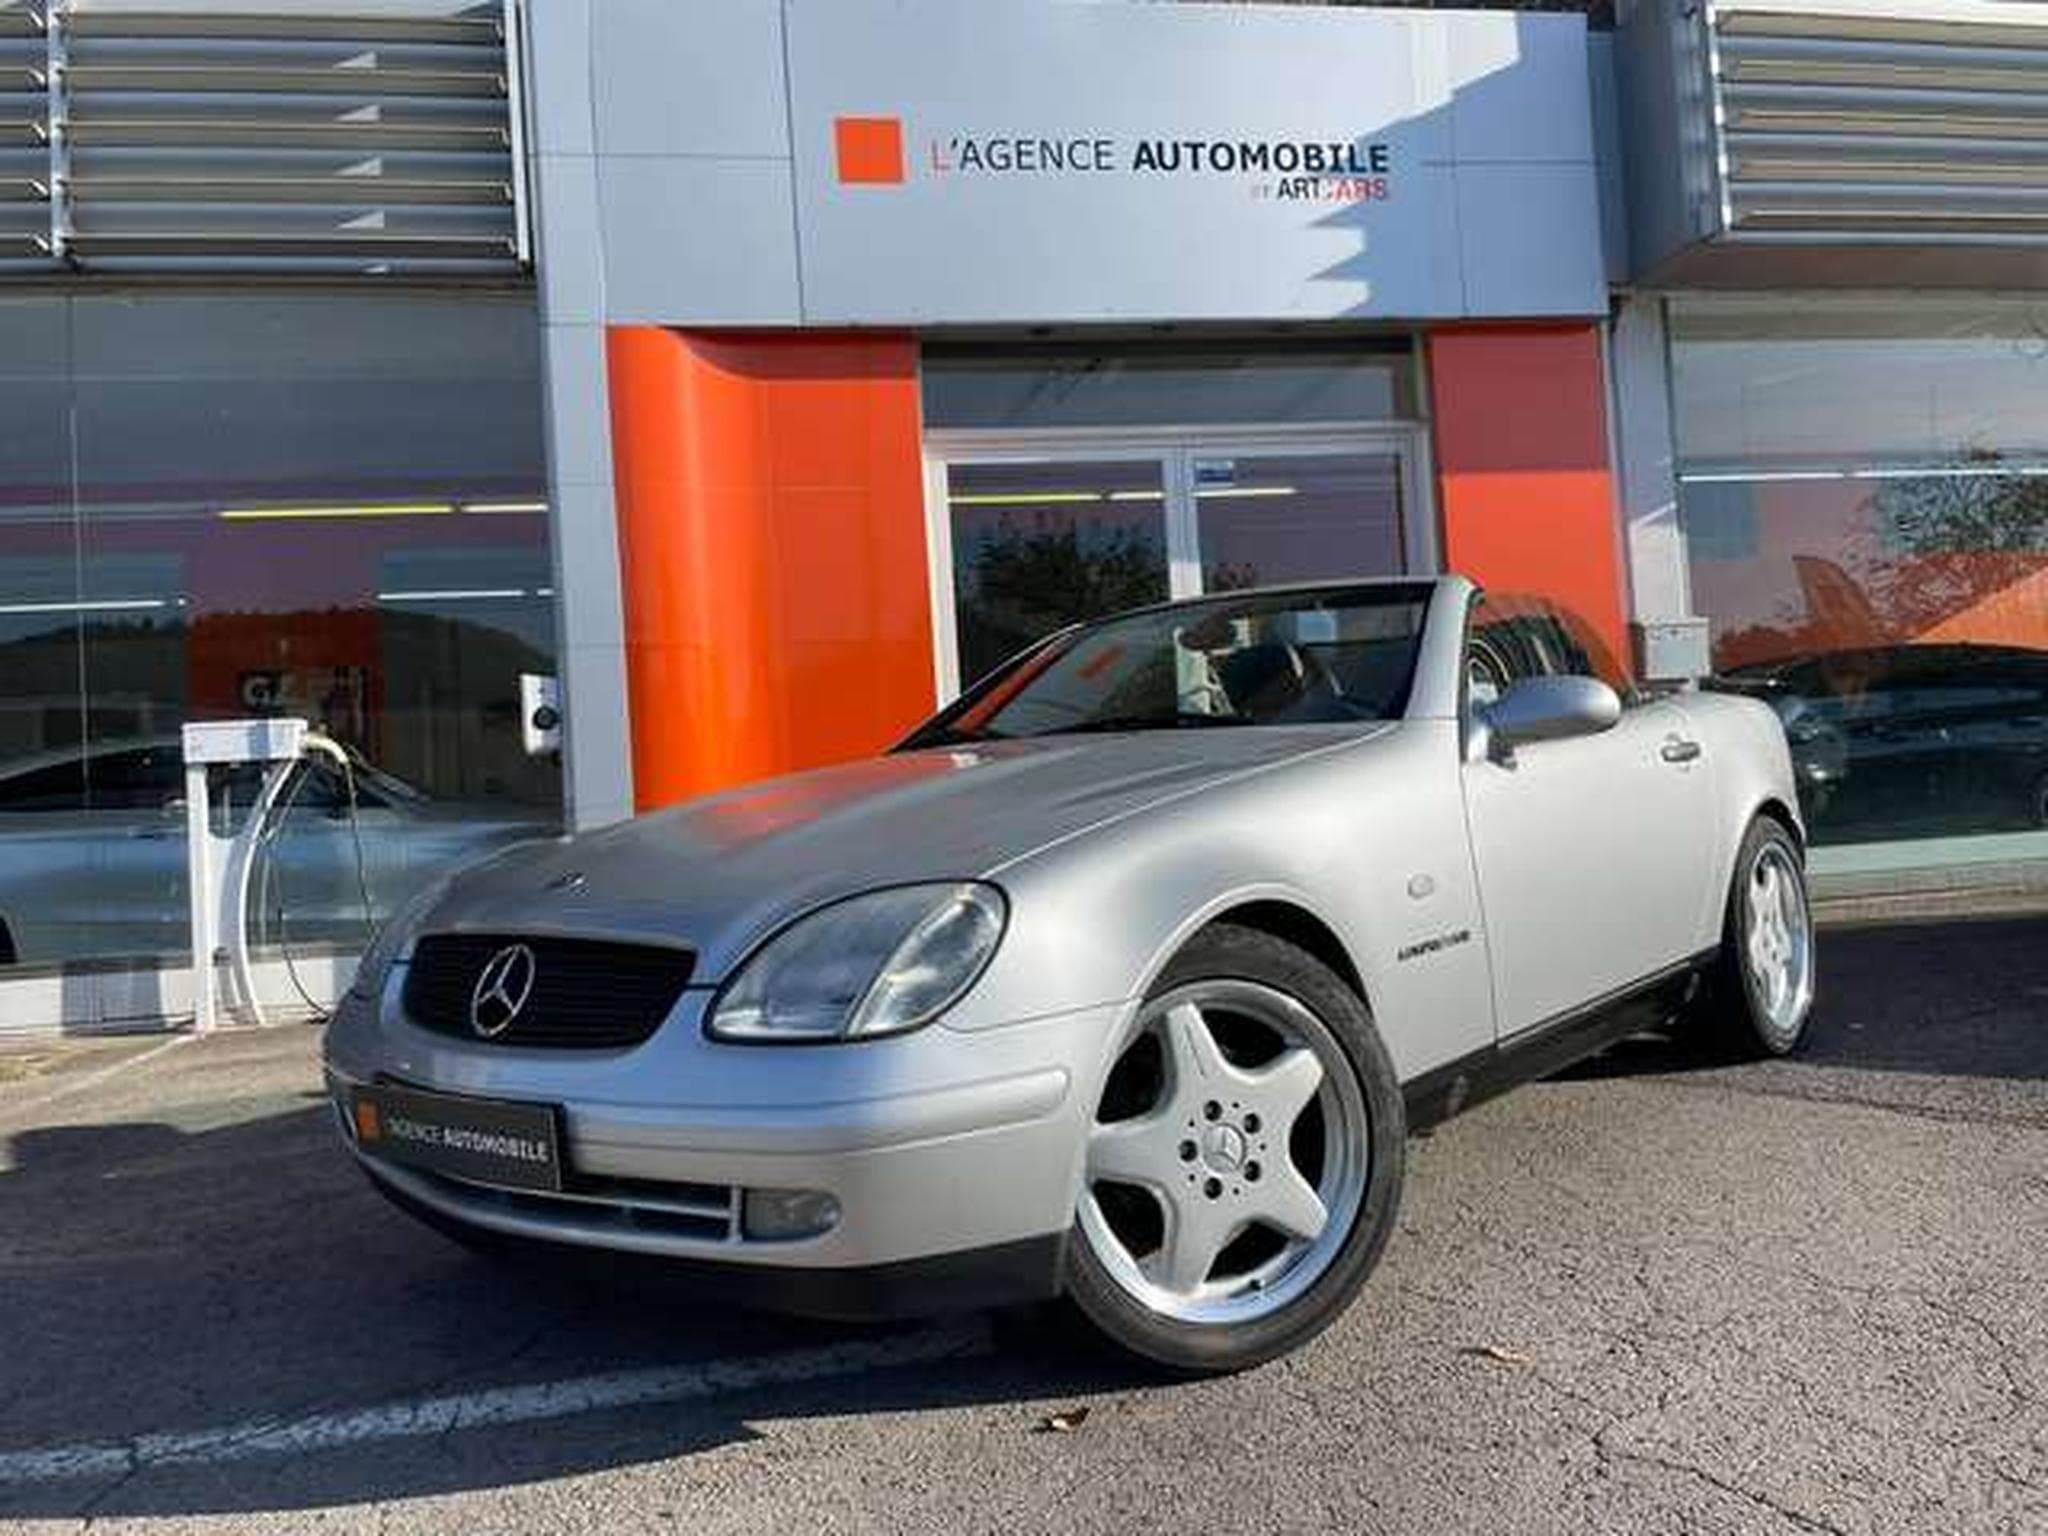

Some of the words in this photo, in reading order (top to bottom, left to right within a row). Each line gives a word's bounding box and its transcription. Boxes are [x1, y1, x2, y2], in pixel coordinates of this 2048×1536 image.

[931, 137, 1116, 172] L'AGENCE
[1132, 140, 1389, 174] AUTOMOBILE
[1277, 176, 1387, 201] ARTARS
[444, 1127, 549, 1162] AUTOMOBILE
